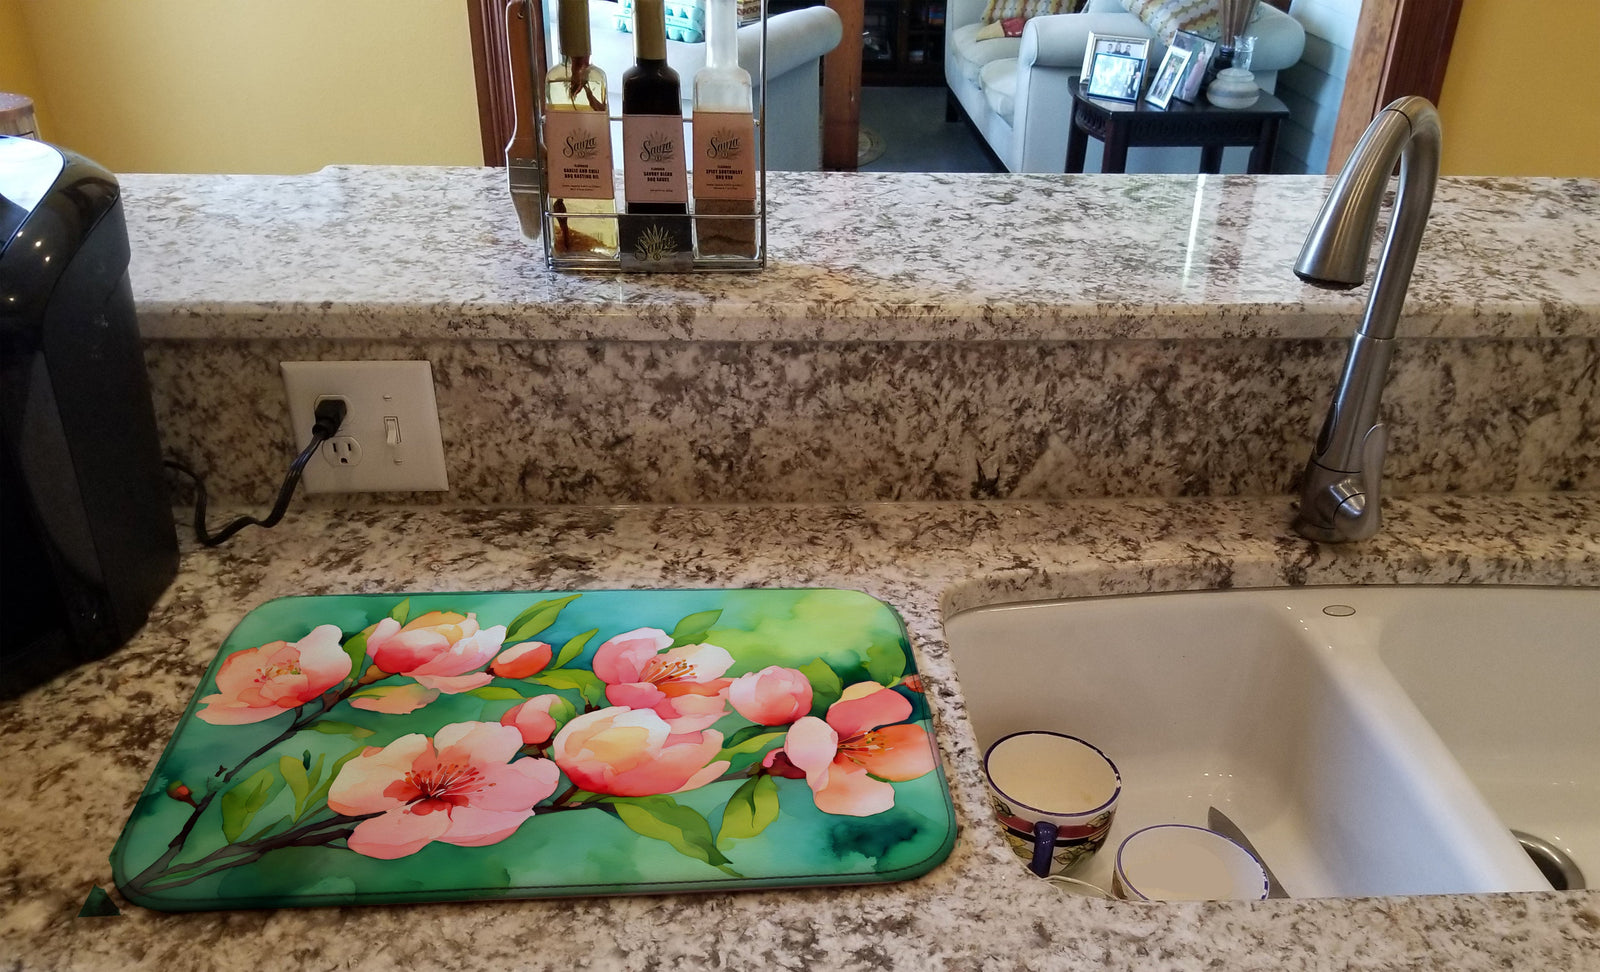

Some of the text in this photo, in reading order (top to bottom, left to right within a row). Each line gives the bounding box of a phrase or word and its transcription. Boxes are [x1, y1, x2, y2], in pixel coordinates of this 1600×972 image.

[563, 136, 597, 158] Sauza
[640, 140, 674, 162] Sauza
[707, 136, 740, 158] Sauza
